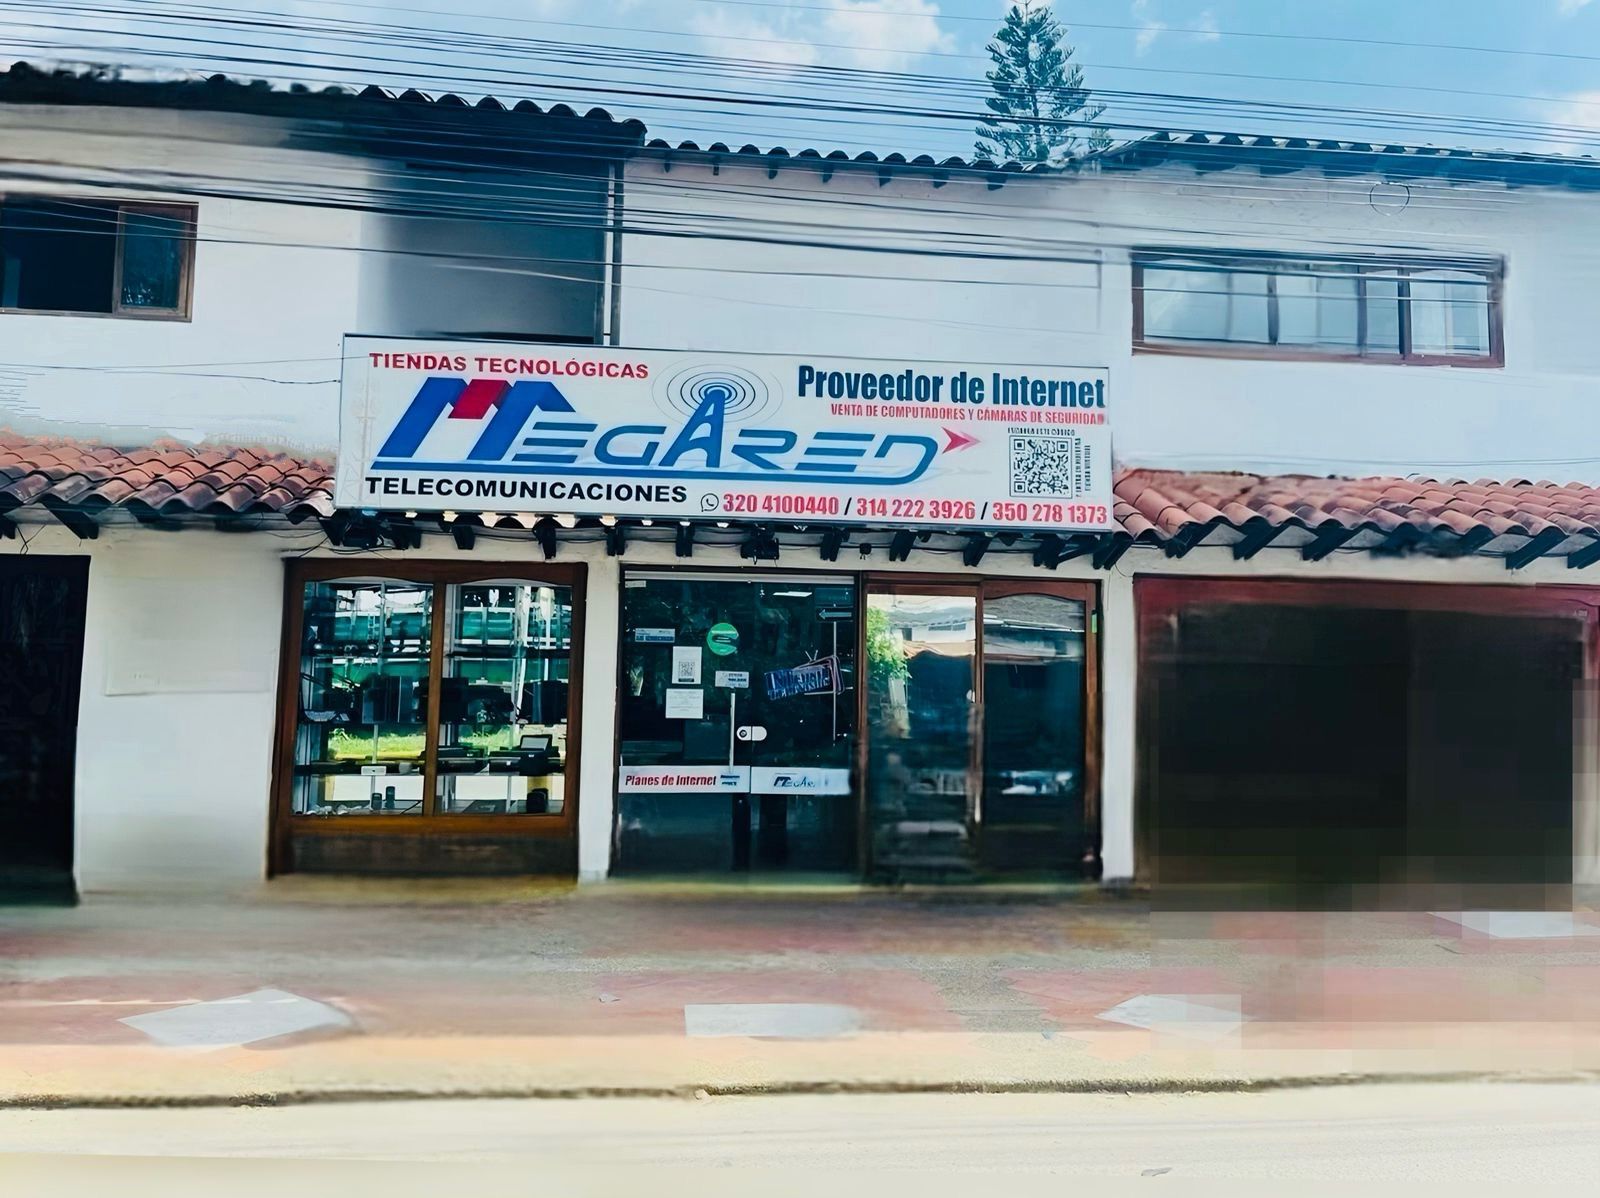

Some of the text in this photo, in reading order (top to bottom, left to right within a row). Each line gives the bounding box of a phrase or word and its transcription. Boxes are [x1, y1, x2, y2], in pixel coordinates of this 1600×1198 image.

[369, 352, 649, 379] TIENDAS TECNOLÓGICAS
[797, 364, 1106, 409] Proveedor de Internet
[831, 403, 1105, 425] VENTA DE COMPUTADORES Y CÁMARAS DE SEGURIDAD
[365, 476, 688, 503] TELECOMUNICACIONES
[723, 494, 1108, 524] 320 4100440 / 314 222 3926 / 350 278 1373
[625, 775, 659, 786] Planes
[661, 775, 674, 786] de
[676, 775, 717, 786] Internet
